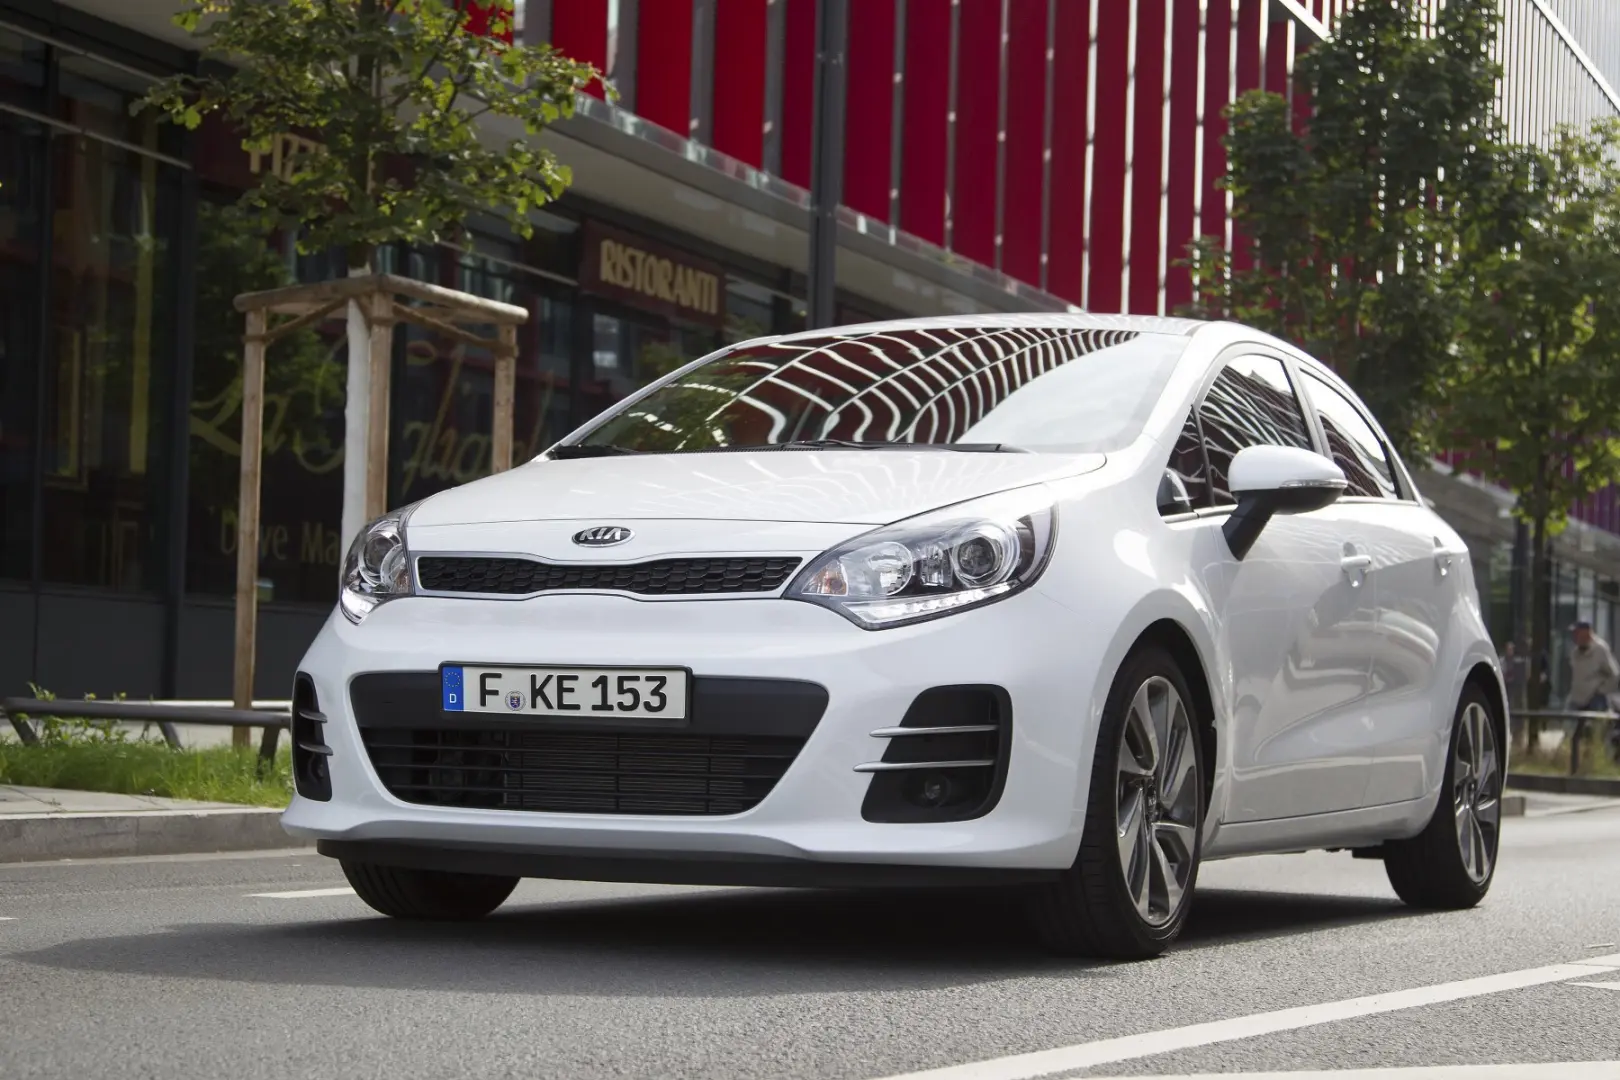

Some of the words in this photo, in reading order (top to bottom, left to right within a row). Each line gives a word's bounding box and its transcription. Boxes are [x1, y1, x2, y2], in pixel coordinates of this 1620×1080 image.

[600, 239, 718, 315] RISTORANTI
[579, 527, 622, 541] KIA
[448, 693, 458, 704] D
[479, 673, 502, 707] F
[530, 674, 581, 710] KE
[591, 675, 668, 712] 153
